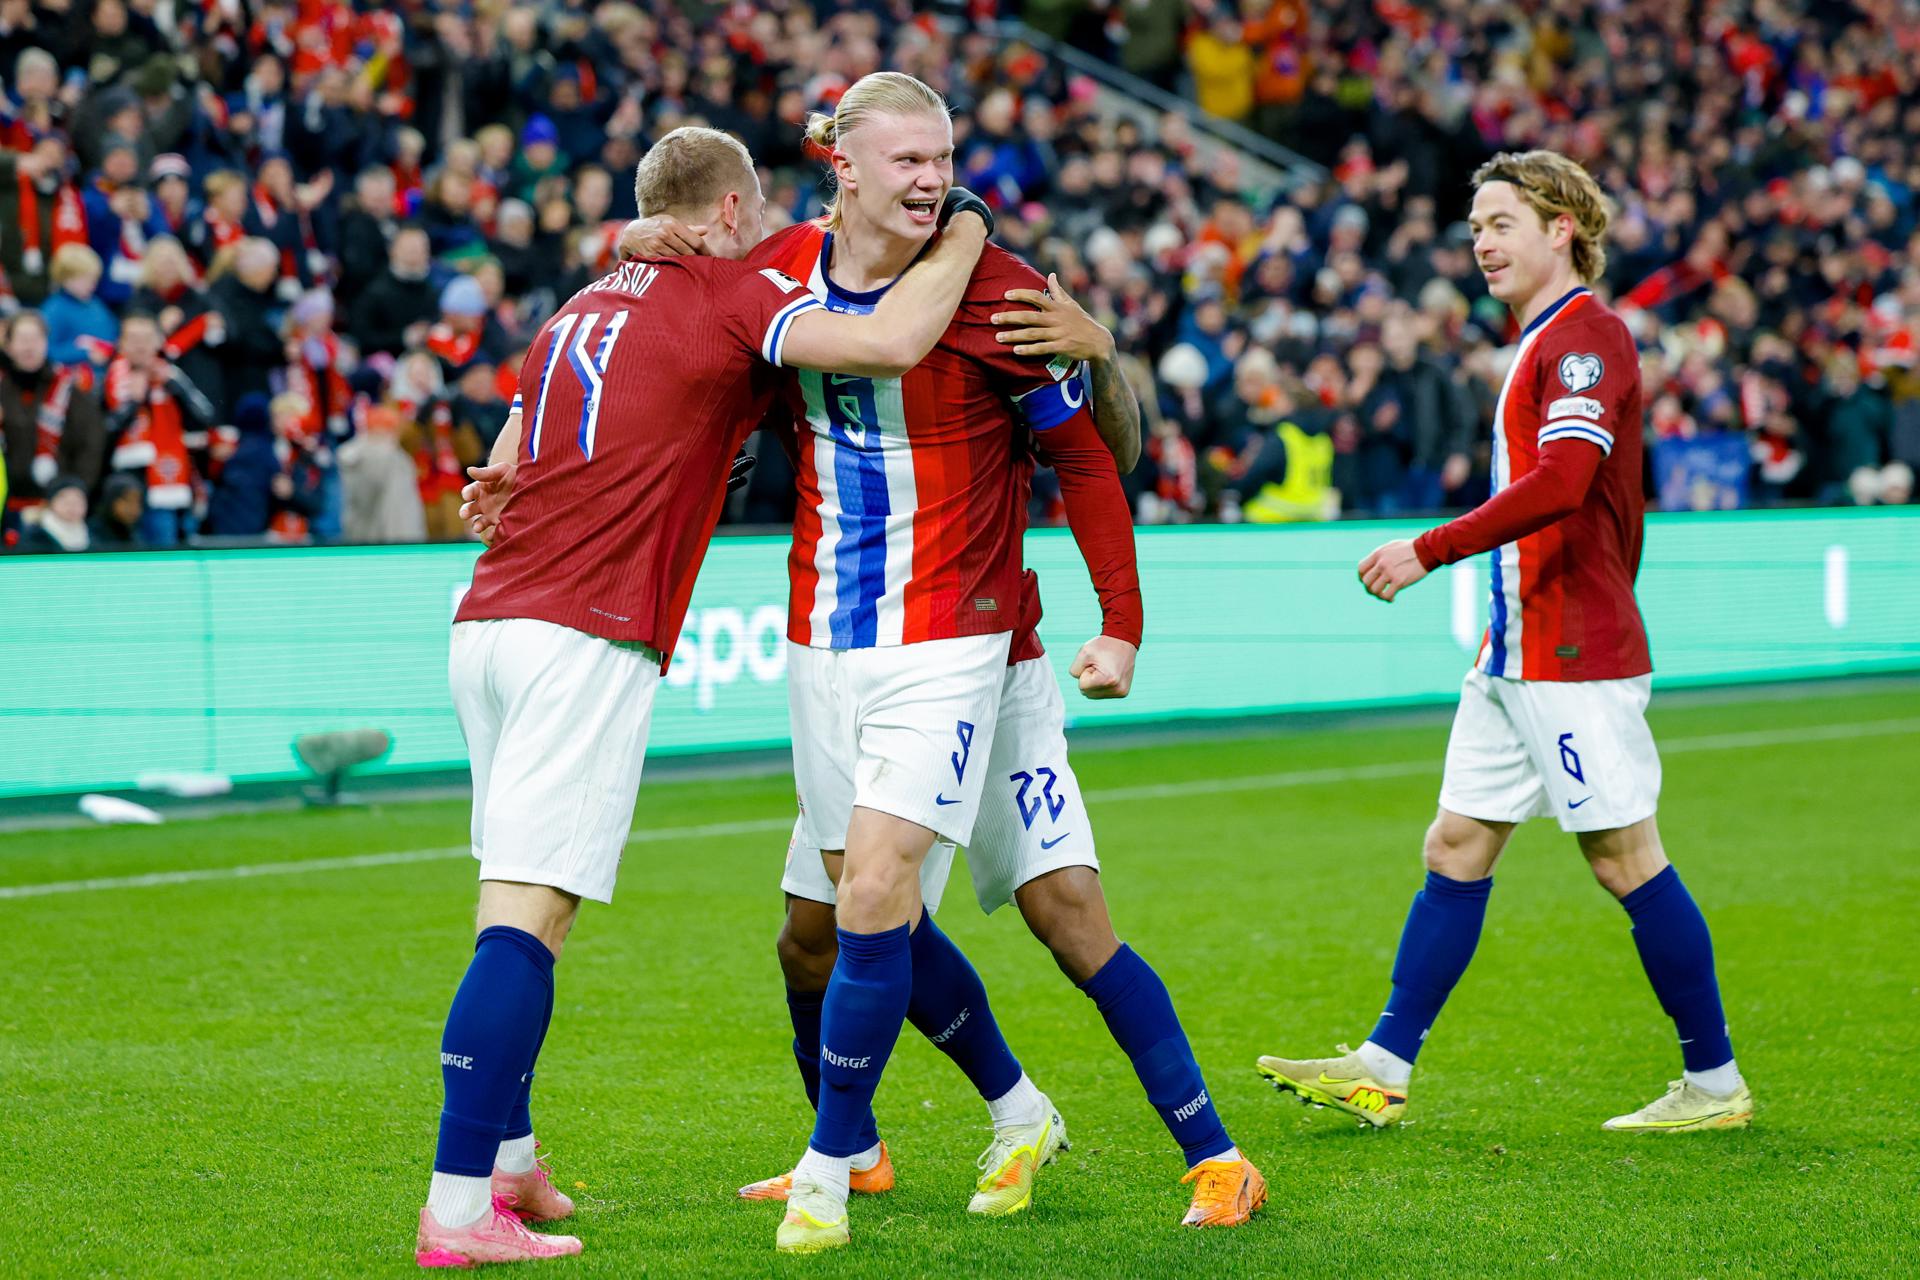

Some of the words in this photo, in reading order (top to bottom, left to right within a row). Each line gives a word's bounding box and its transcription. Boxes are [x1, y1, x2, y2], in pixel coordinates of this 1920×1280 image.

[567, 261, 660, 304] ERSON
[528, 309, 630, 463] 14
[837, 395, 866, 449] 9
[951, 720, 975, 787] 9
[1558, 732, 1586, 785] 6
[1010, 767, 1066, 831] 22
[441, 1052, 474, 1070] ORGE
[822, 1044, 871, 1069] NORGE
